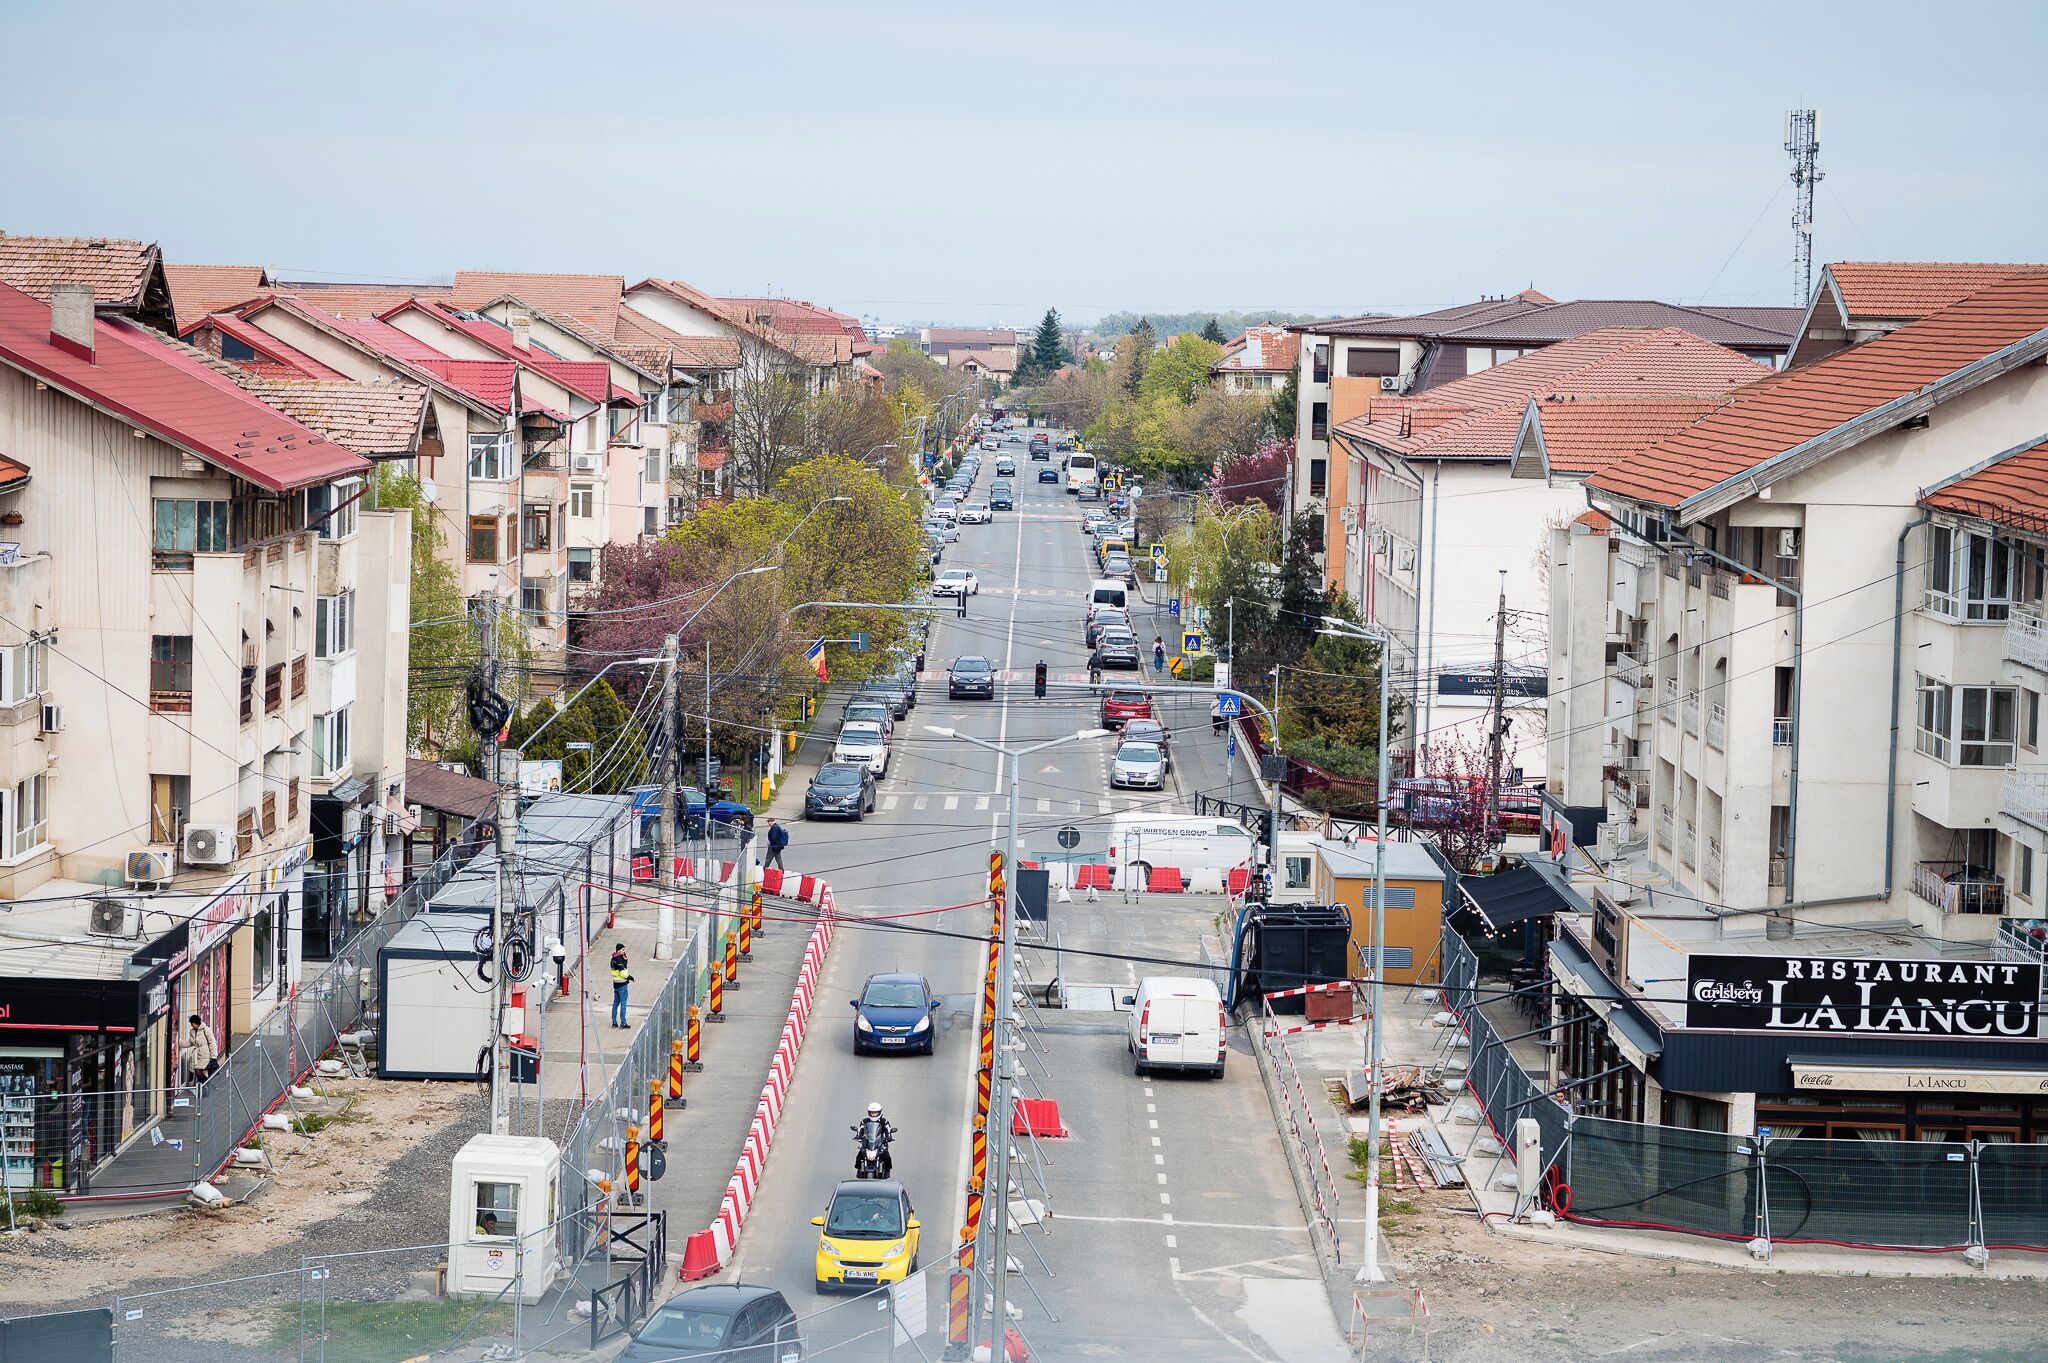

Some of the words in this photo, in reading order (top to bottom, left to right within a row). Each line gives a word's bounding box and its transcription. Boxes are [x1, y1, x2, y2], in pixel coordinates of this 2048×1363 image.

[1171, 600, 1177, 610] P
[1143, 828, 1178, 836] WIRTGEN
[1179, 829, 1207, 837] GROUP
[1786, 959, 2019, 985] RESTAURANT
[1692, 978, 1763, 1004] Carlsberg
[1765, 979, 1847, 1030] LA
[1853, 981, 2034, 1035] IANCU
[1907, 1075, 1924, 1088] LA
[1928, 1076, 1967, 1089] IANCU
